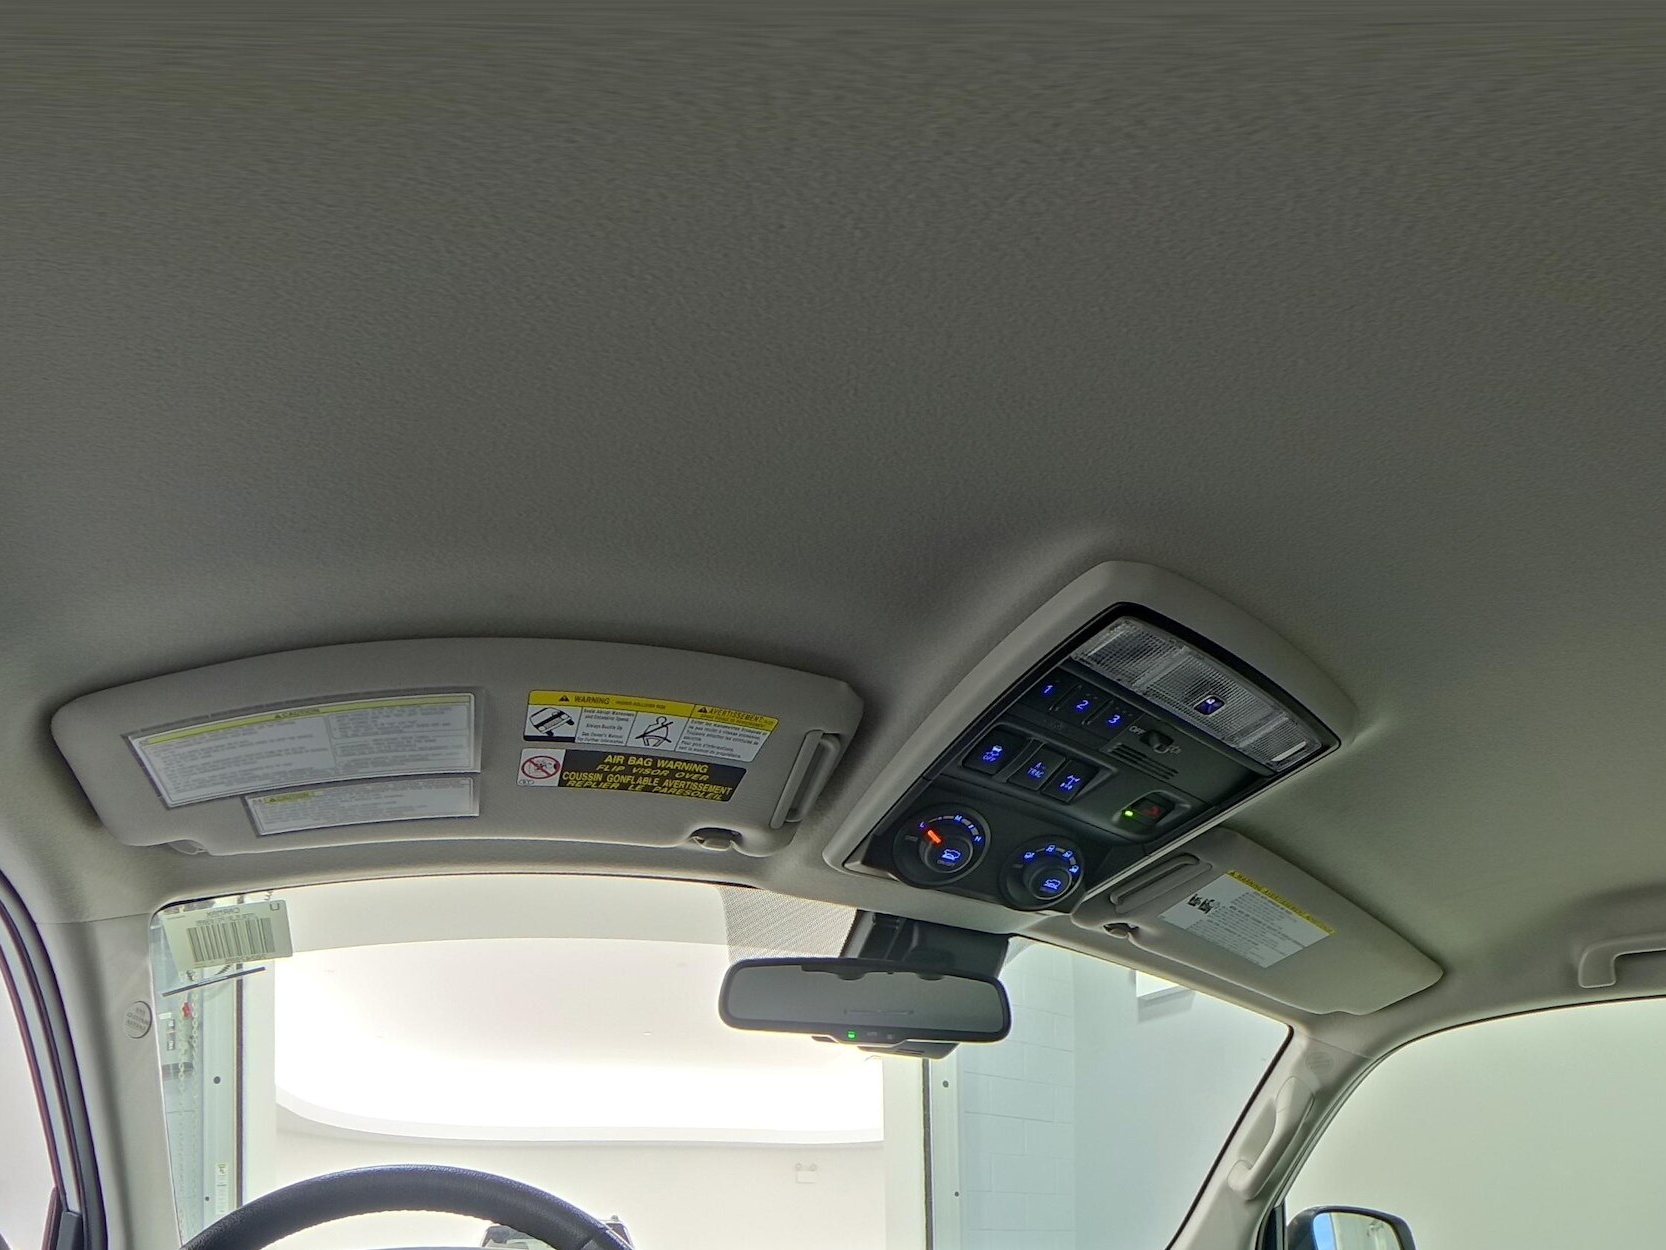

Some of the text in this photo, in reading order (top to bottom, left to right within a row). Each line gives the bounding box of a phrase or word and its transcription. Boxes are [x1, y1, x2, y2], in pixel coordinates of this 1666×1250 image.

[1044, 685, 1054, 694] 1
[574, 695, 610, 705] WARNING
[1076, 700, 1089, 711] 2
[1108, 714, 1121, 725] 3
[603, 754, 709, 773] AIR BAG WARNING
[596, 764, 710, 781] FLIP VISOR OVER
[562, 771, 733, 795] COUSSIN GONFLABLE AVERTISSEMENT
[565, 780, 620, 790] REPLIER
